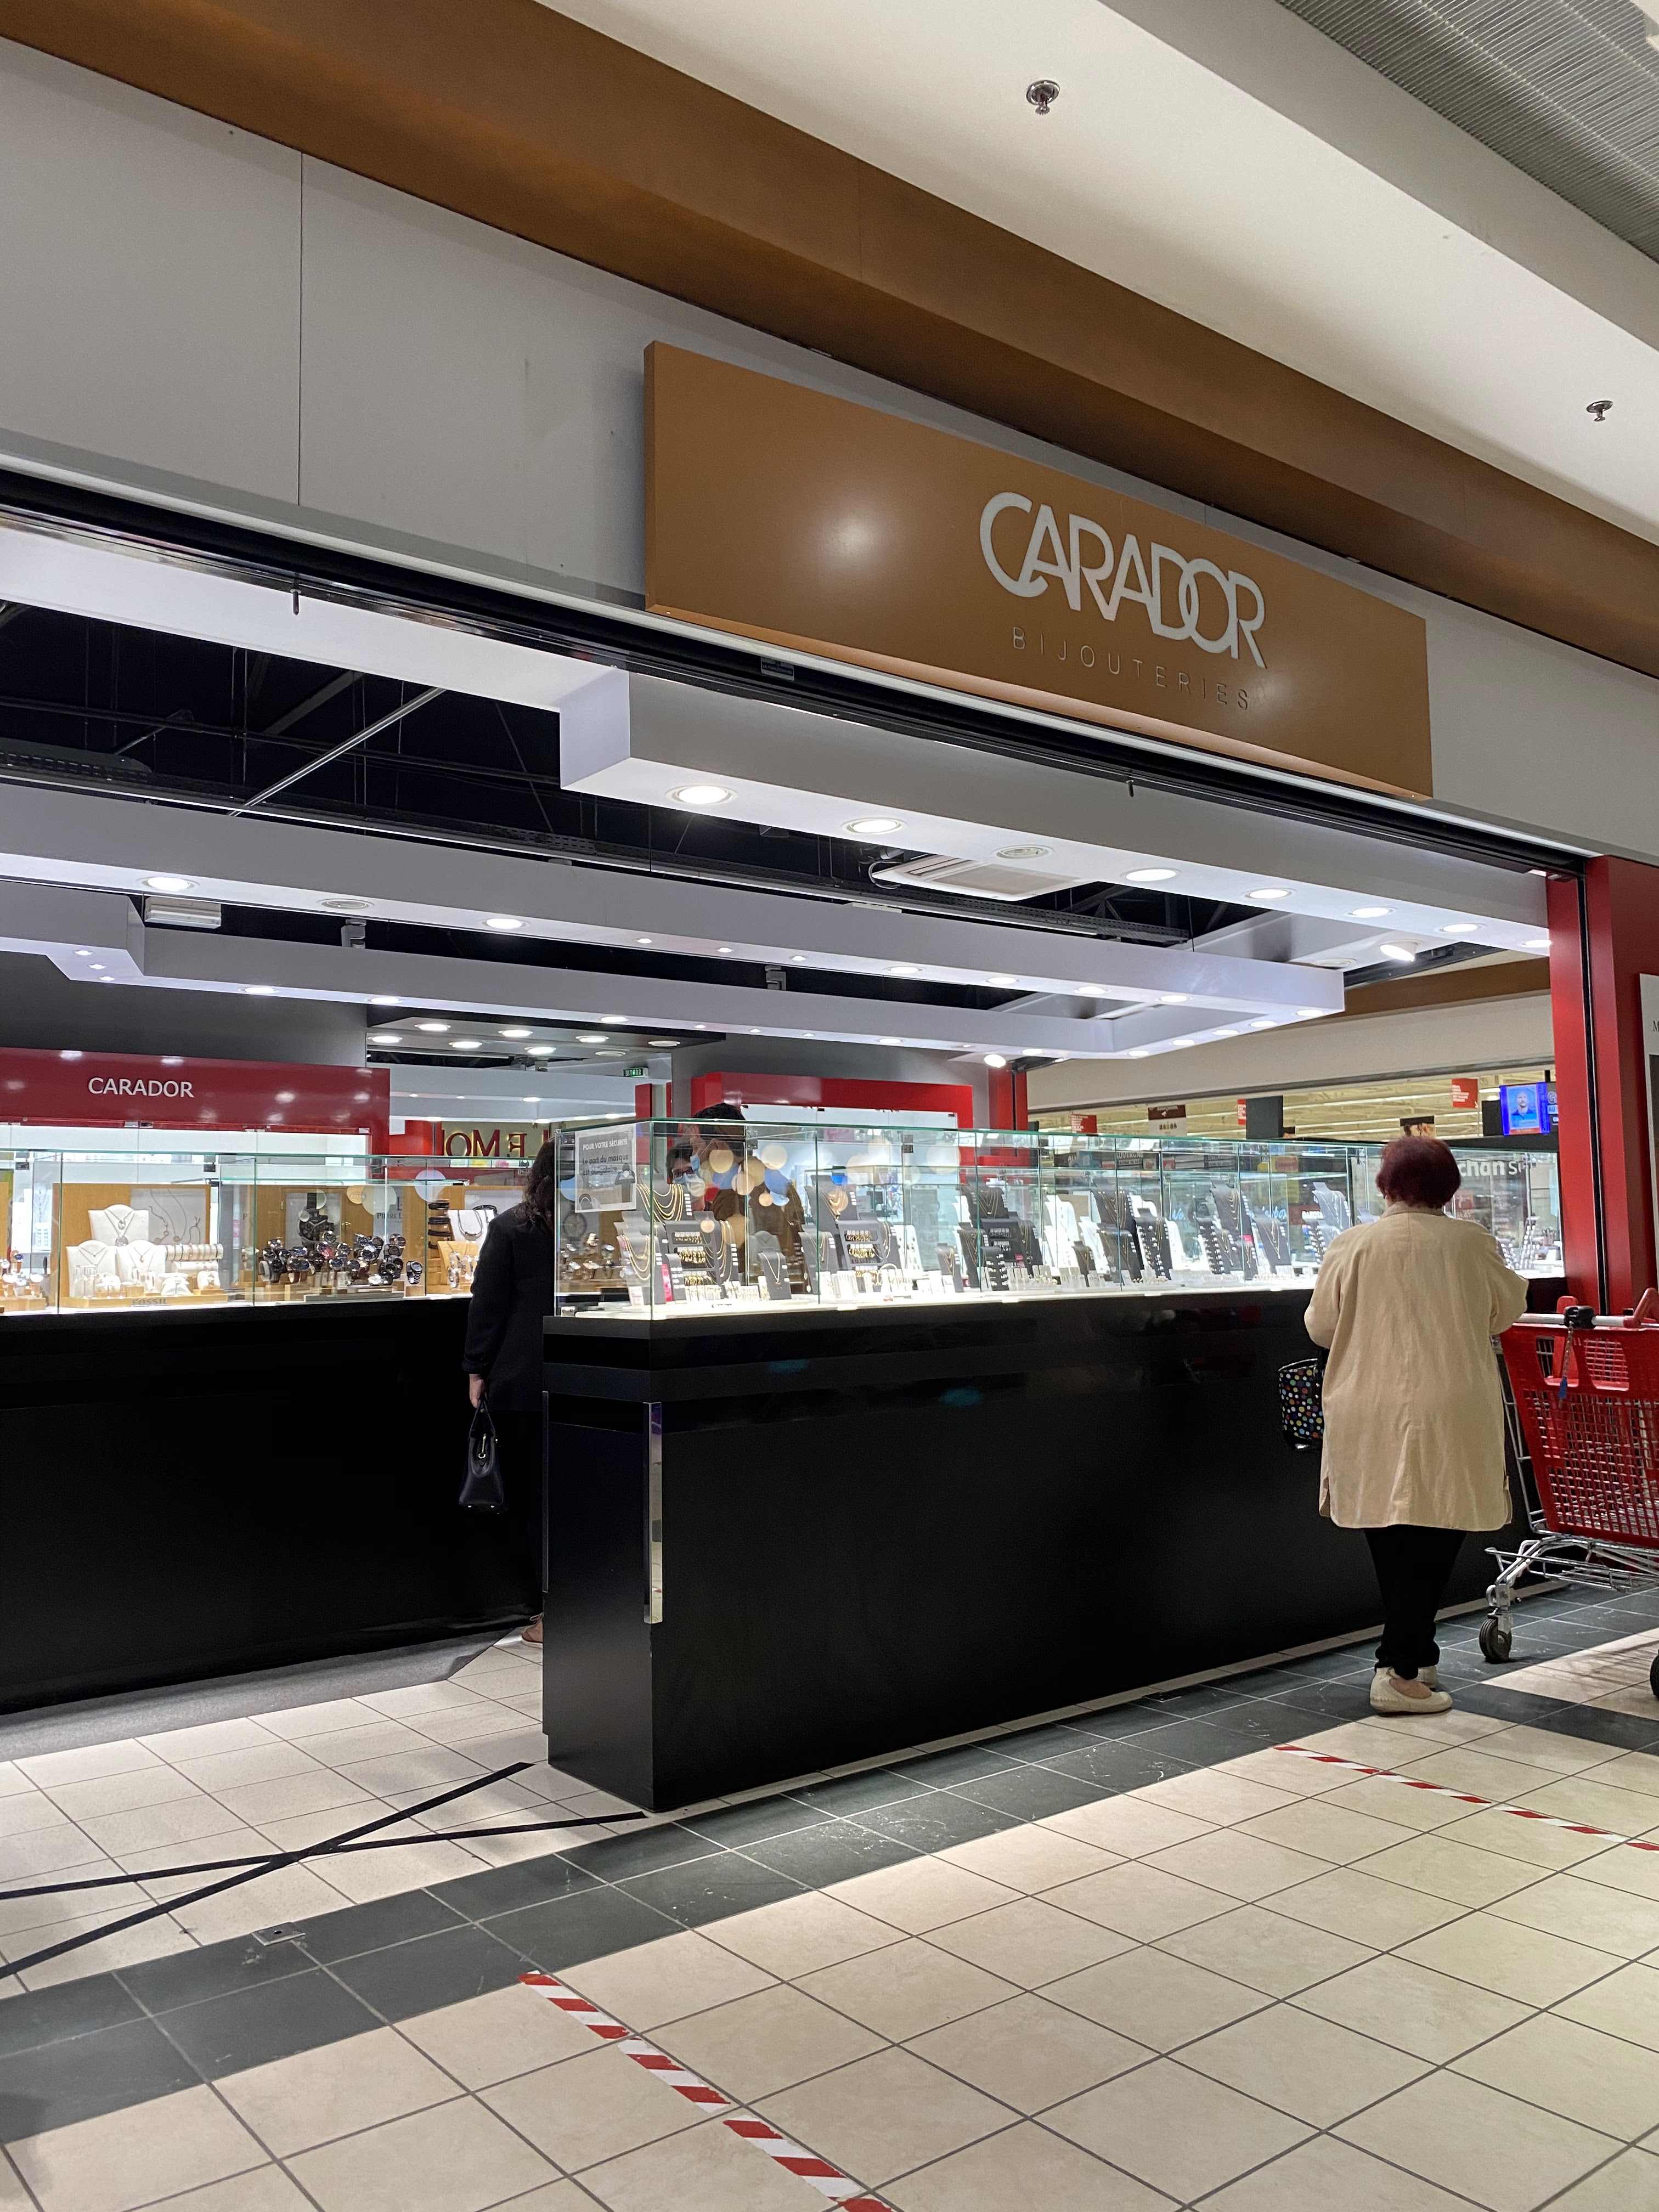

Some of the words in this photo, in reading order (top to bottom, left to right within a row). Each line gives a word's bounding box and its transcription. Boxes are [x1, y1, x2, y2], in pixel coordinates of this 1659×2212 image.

[979, 492, 1267, 669] CARADOR
[1012, 626, 1249, 710] BIJOUTERIES
[88, 1077, 194, 1098] CARADOR
[609, 1137, 628, 1147] SÉCURITÉ
[608, 1154, 629, 1163] masque
[1457, 1160, 1505, 1177] chan
